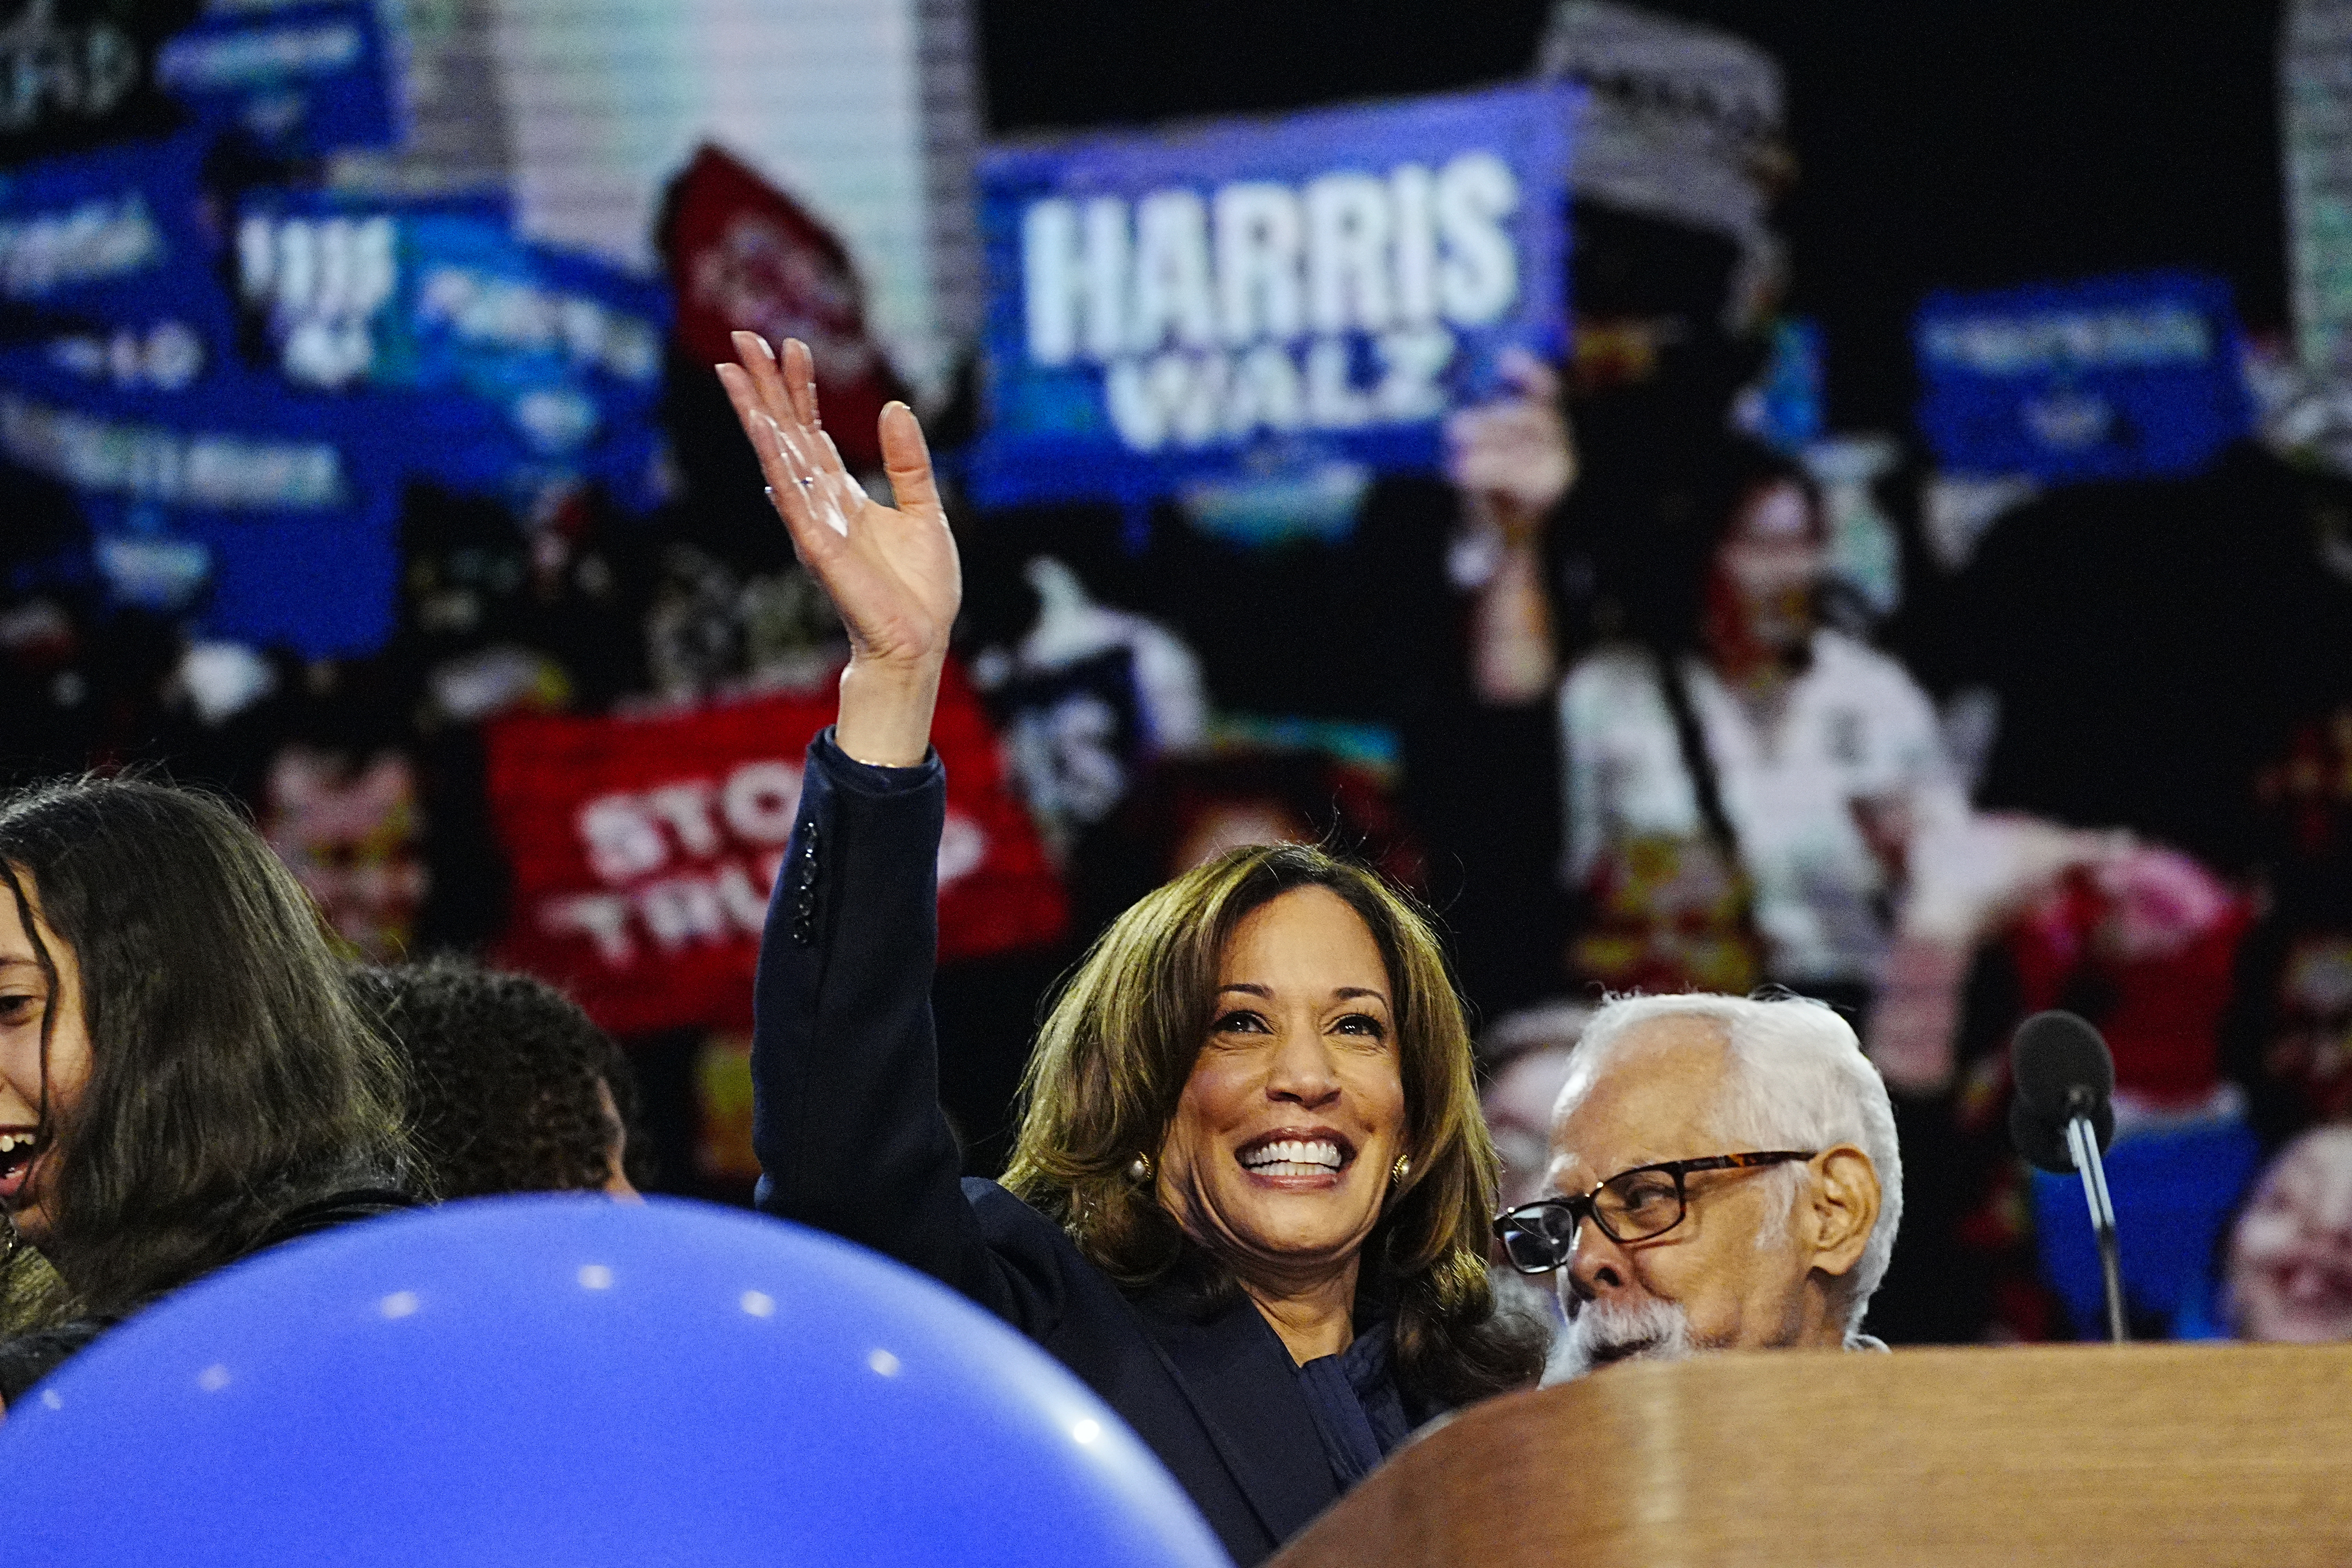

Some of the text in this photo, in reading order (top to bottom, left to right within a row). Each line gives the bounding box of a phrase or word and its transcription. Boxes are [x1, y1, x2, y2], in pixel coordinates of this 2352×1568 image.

[1023, 151, 1518, 365] HARRIS
[1105, 329, 1454, 453] WALZ
[579, 760, 807, 885] STO
